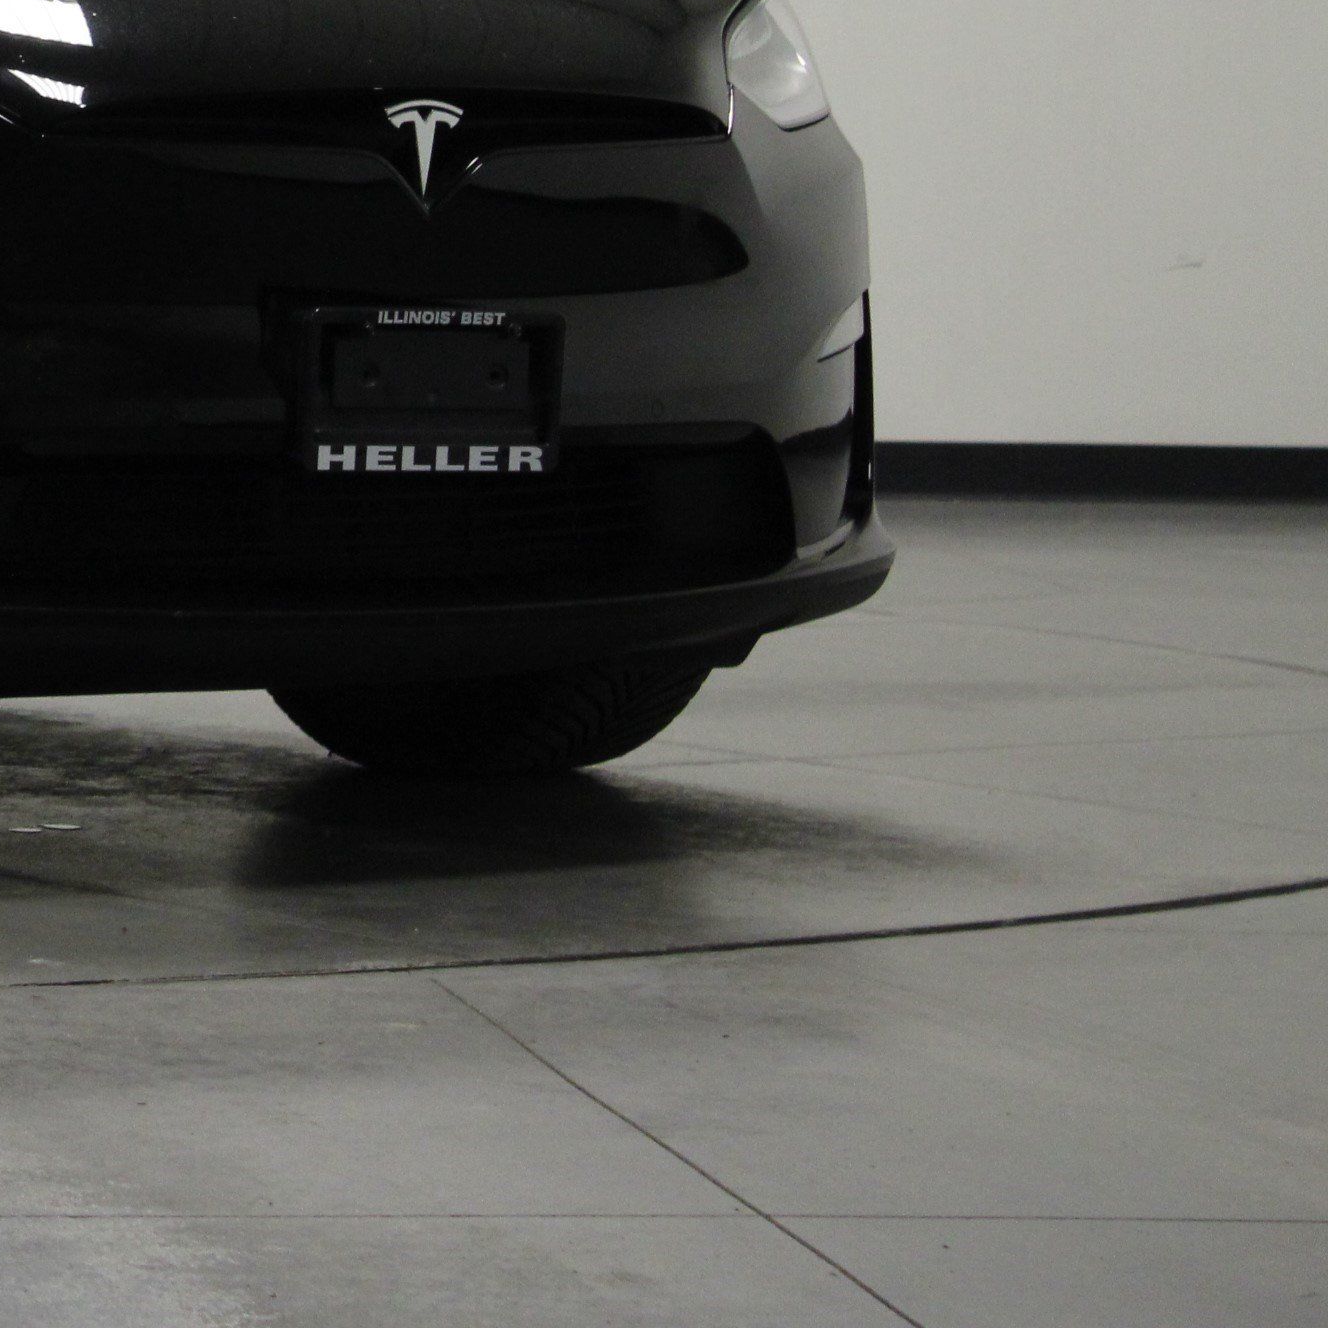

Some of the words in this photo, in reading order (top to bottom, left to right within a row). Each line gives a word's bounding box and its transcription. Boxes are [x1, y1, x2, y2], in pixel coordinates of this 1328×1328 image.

[377, 309, 456, 326] ILLINOIS'
[460, 311, 506, 327] BEST
[316, 445, 544, 472] HELLER
